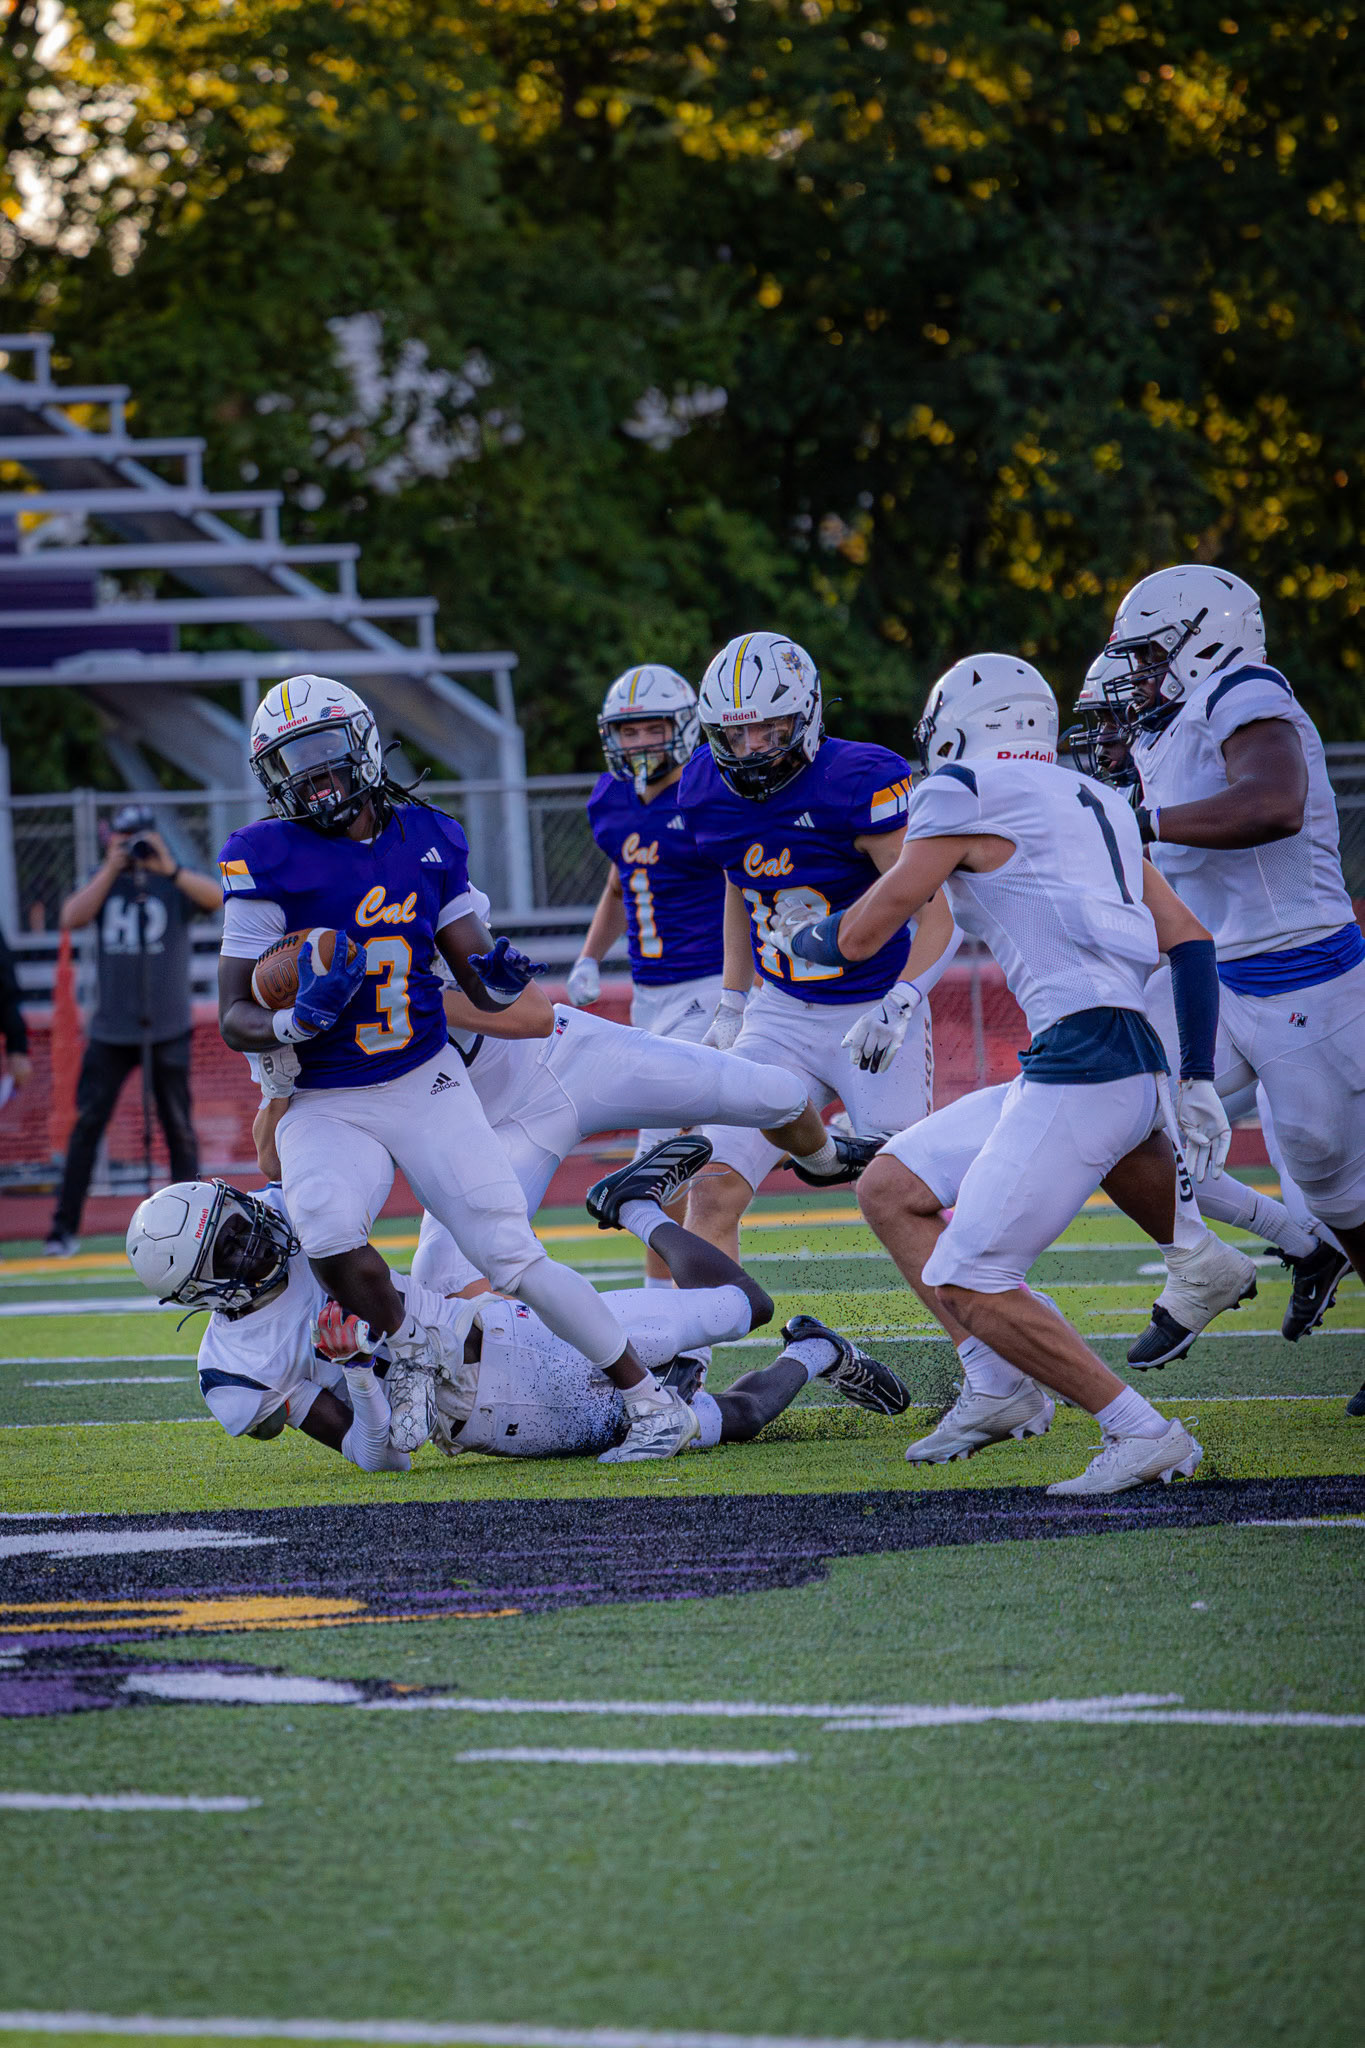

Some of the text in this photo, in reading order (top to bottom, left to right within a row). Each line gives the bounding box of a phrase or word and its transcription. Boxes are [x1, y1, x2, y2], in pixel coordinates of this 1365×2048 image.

[277, 715, 309, 733] Riddell
[722, 711, 757, 722] Riddell
[622, 832, 659, 865] Cal
[743, 843, 794, 877] Cal
[1076, 783, 1134, 904] 1
[355, 886, 417, 927] Cal
[629, 868, 663, 958] 1
[355, 936, 413, 1055] 3
[430, 1081, 460, 1095] adidas
[195, 1208, 209, 1239] Riddell
